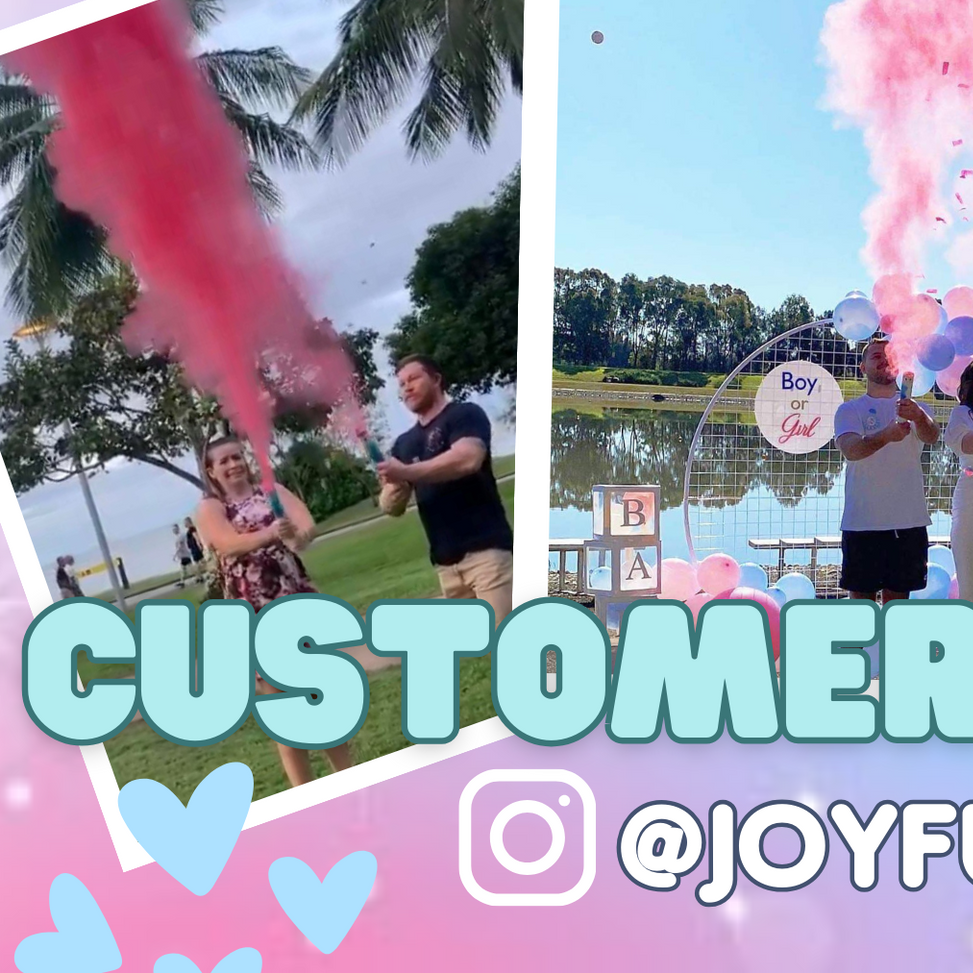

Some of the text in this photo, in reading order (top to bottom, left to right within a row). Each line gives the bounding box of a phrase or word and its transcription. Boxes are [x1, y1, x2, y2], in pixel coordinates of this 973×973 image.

[781, 371, 818, 396] Boy
[790, 399, 809, 410] or
[778, 413, 821, 444] Girl
